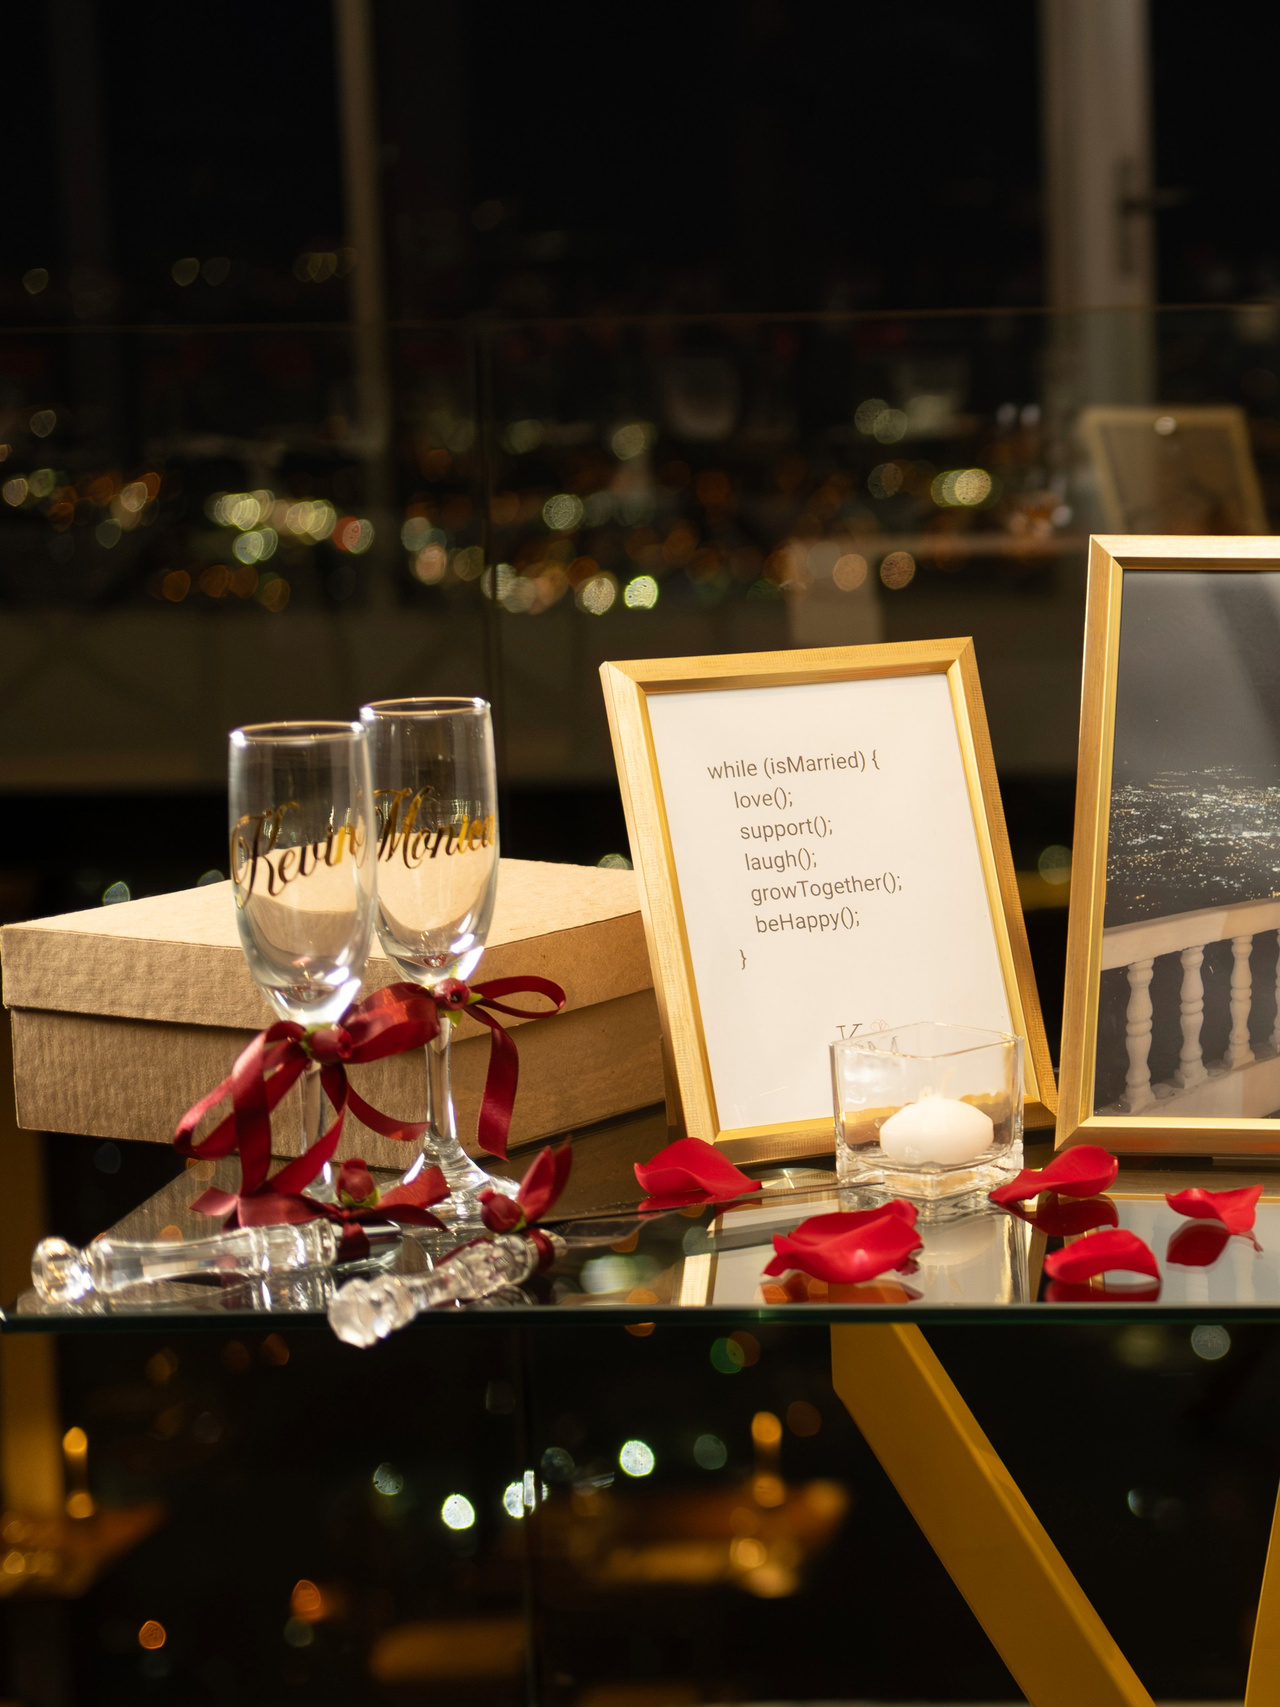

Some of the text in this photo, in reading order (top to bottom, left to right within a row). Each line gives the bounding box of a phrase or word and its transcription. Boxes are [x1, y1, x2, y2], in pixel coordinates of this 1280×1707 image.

[707, 761, 757, 780] while
[763, 751, 866, 780] (isMarried)
[734, 788, 793, 810] love();
[373, 785, 494, 869] Monica
[740, 816, 833, 843] support();
[231, 801, 364, 909] Kevin
[744, 848, 817, 873] laugh();
[750, 872, 902, 907] growTogether();
[755, 906, 860, 934] beHappy();
